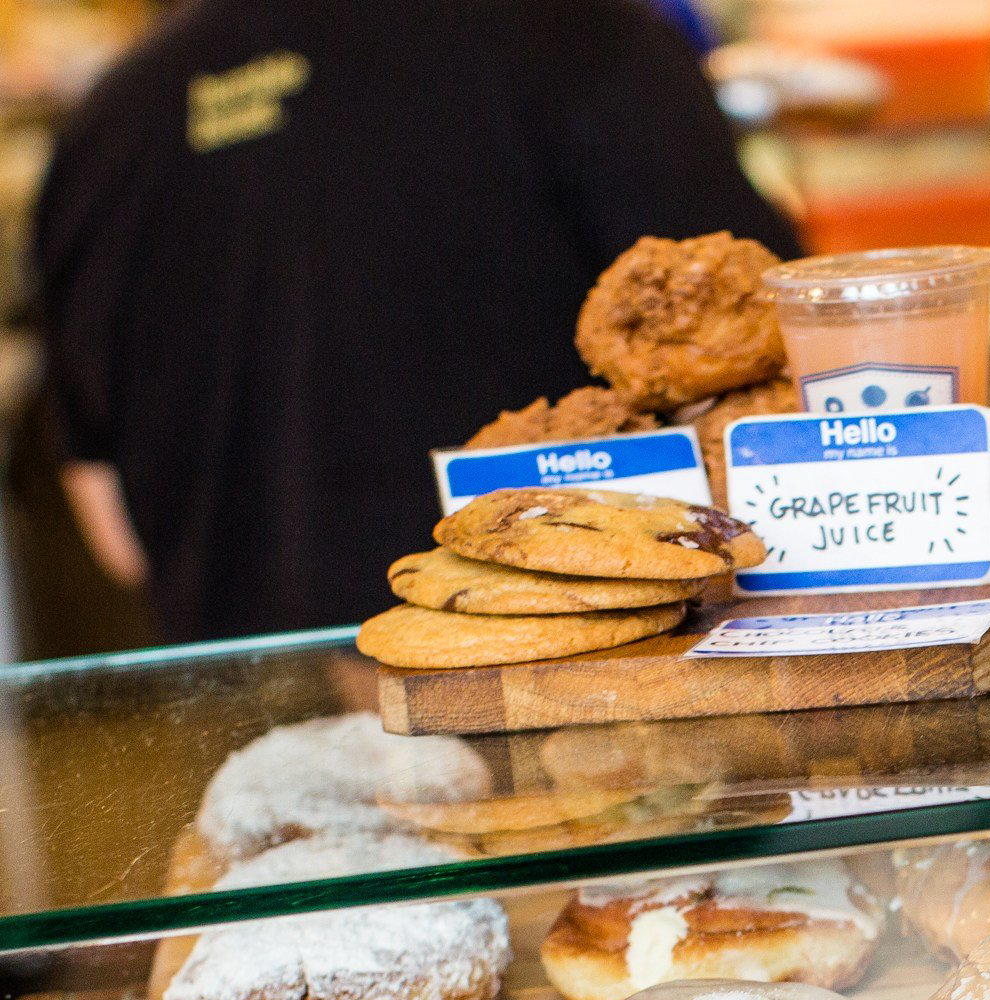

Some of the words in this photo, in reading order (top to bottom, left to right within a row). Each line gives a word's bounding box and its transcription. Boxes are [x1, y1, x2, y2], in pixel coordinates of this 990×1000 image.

[819, 418, 897, 446] Hello
[536, 449, 612, 475] Hello
[812, 522, 896, 551] JUICE
